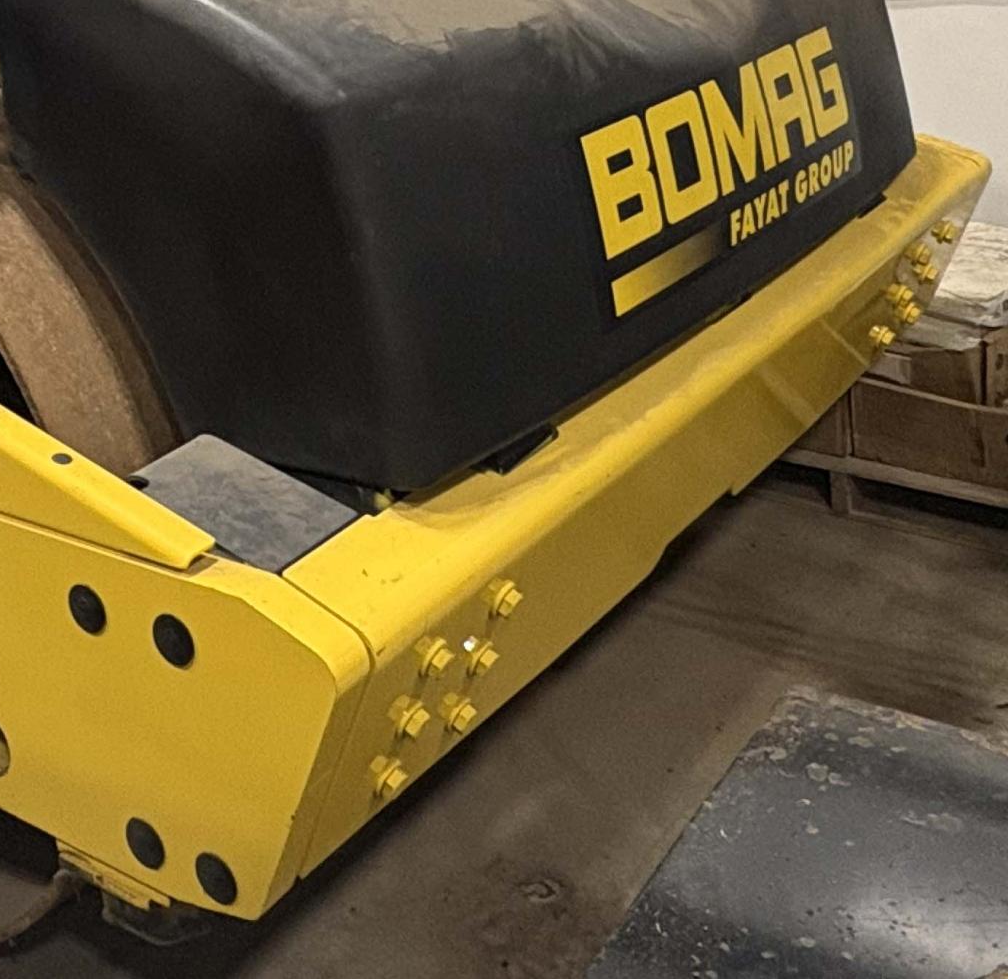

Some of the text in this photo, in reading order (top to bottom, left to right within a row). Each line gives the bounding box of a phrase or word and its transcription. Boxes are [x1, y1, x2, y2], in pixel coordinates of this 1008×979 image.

[580, 26, 849, 260] BOMAG
[729, 140, 855, 247] FAYAT GROUP
